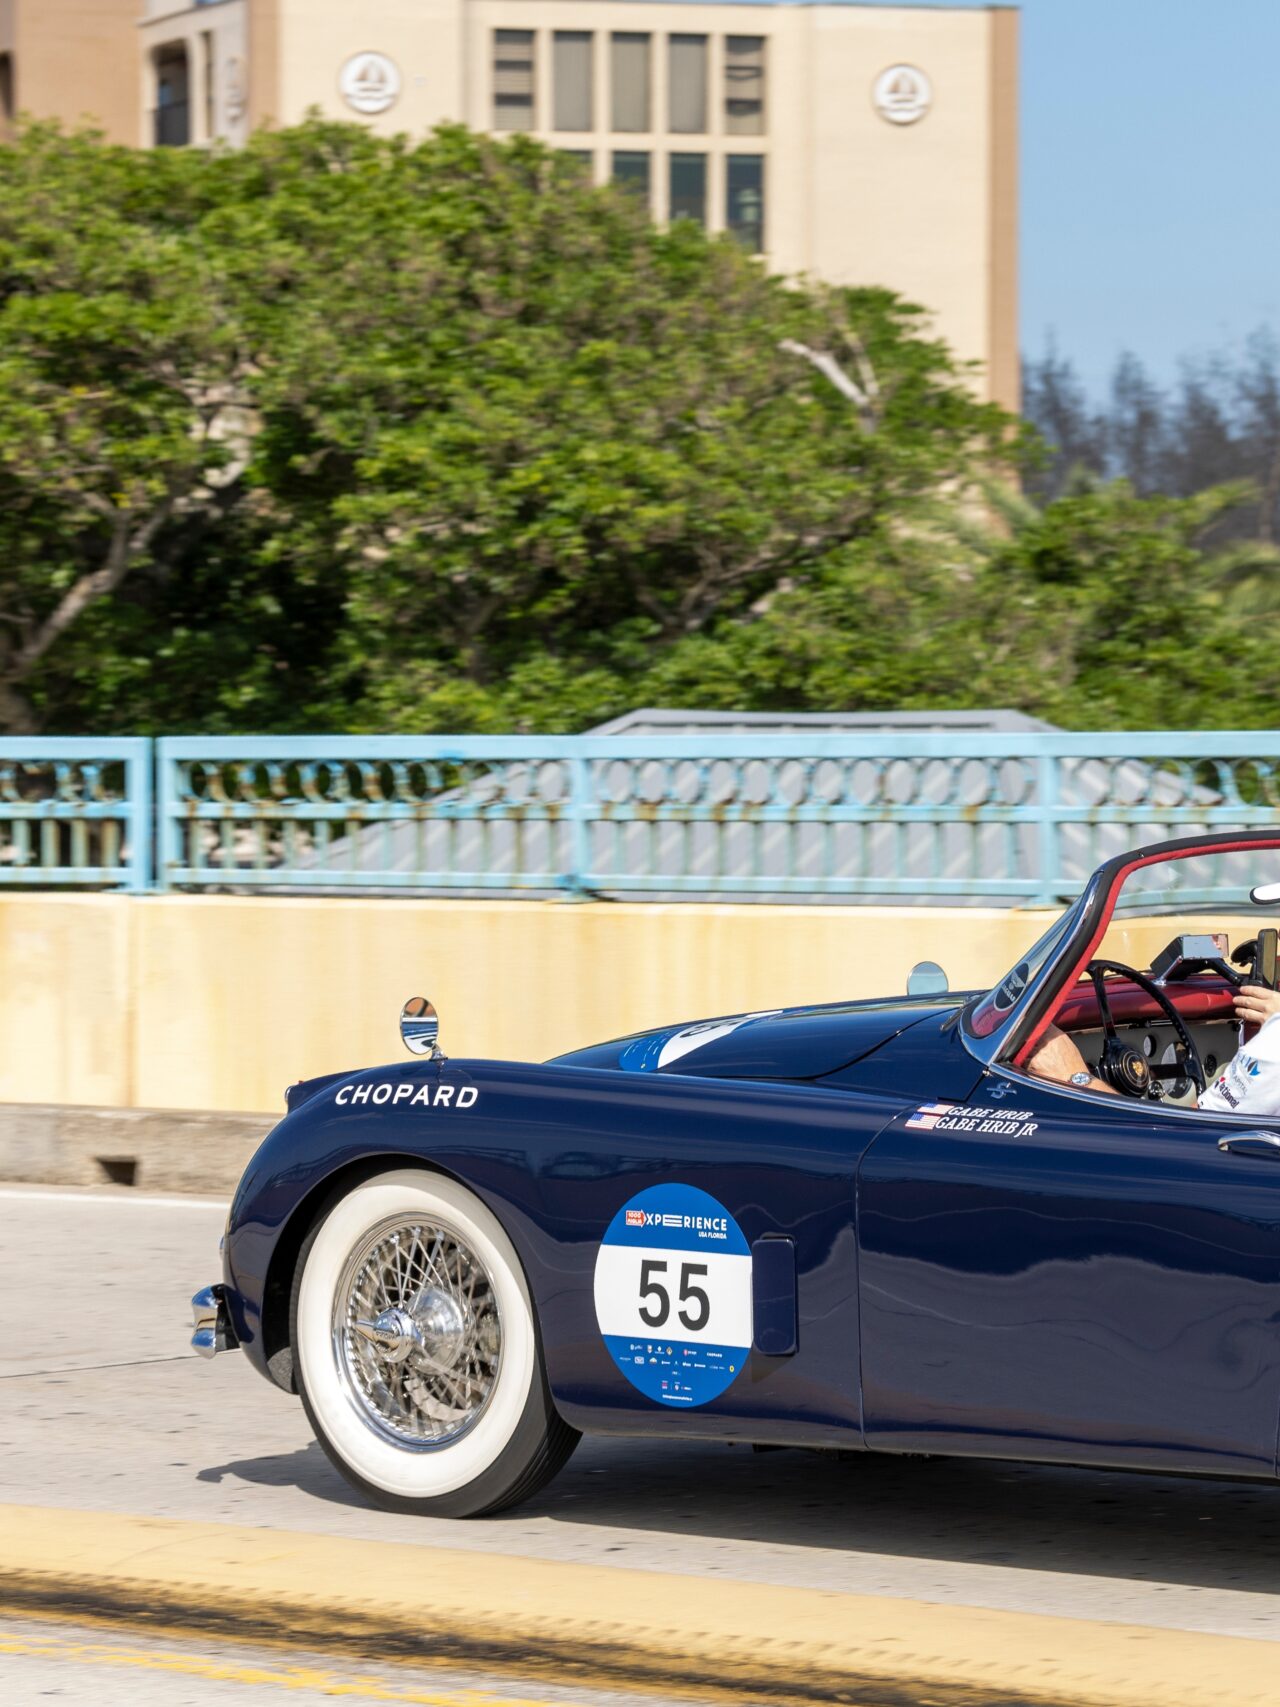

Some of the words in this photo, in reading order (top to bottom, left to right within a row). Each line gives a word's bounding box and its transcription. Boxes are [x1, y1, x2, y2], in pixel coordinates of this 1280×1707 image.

[335, 1083, 479, 1108] CHOPARD
[948, 1107, 993, 1118] GABE
[989, 1110, 1034, 1121] HRIB
[936, 1117, 977, 1131] GABE
[976, 1120, 1020, 1134] HRIB
[1013, 1123, 1039, 1138] JR
[646, 1213, 727, 1231] XPERIENCE
[708, 1232, 727, 1240] FLORIDA
[638, 1259, 711, 1332] 55
